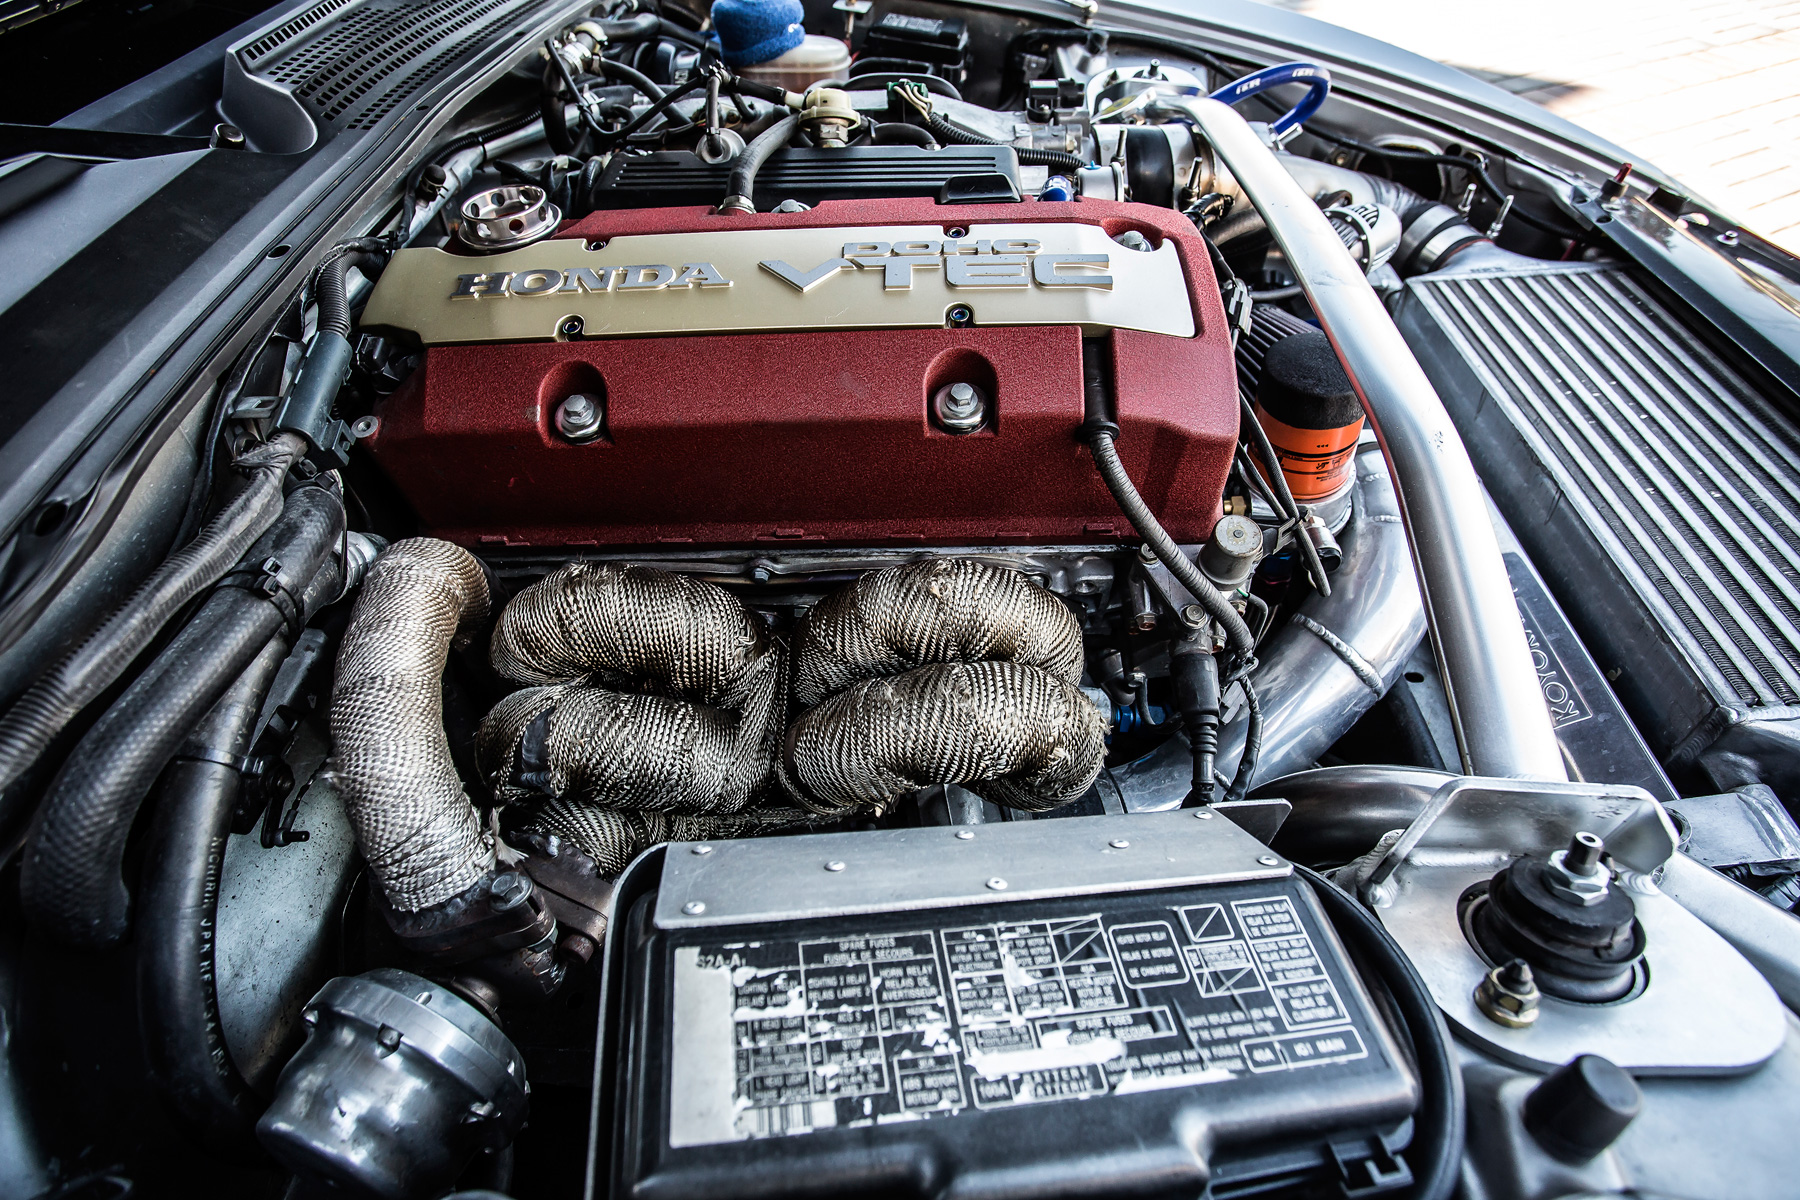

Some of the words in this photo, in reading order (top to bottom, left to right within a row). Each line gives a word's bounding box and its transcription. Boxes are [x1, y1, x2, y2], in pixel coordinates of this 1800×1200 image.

[450, 261, 734, 300] HONDA
[757, 253, 1114, 293] VTEC
[839, 940, 867, 952] SPARE
[868, 937, 896, 949] FUSES
[905, 964, 934, 977] RELAY
[1105, 1014, 1134, 1028] FUSES
